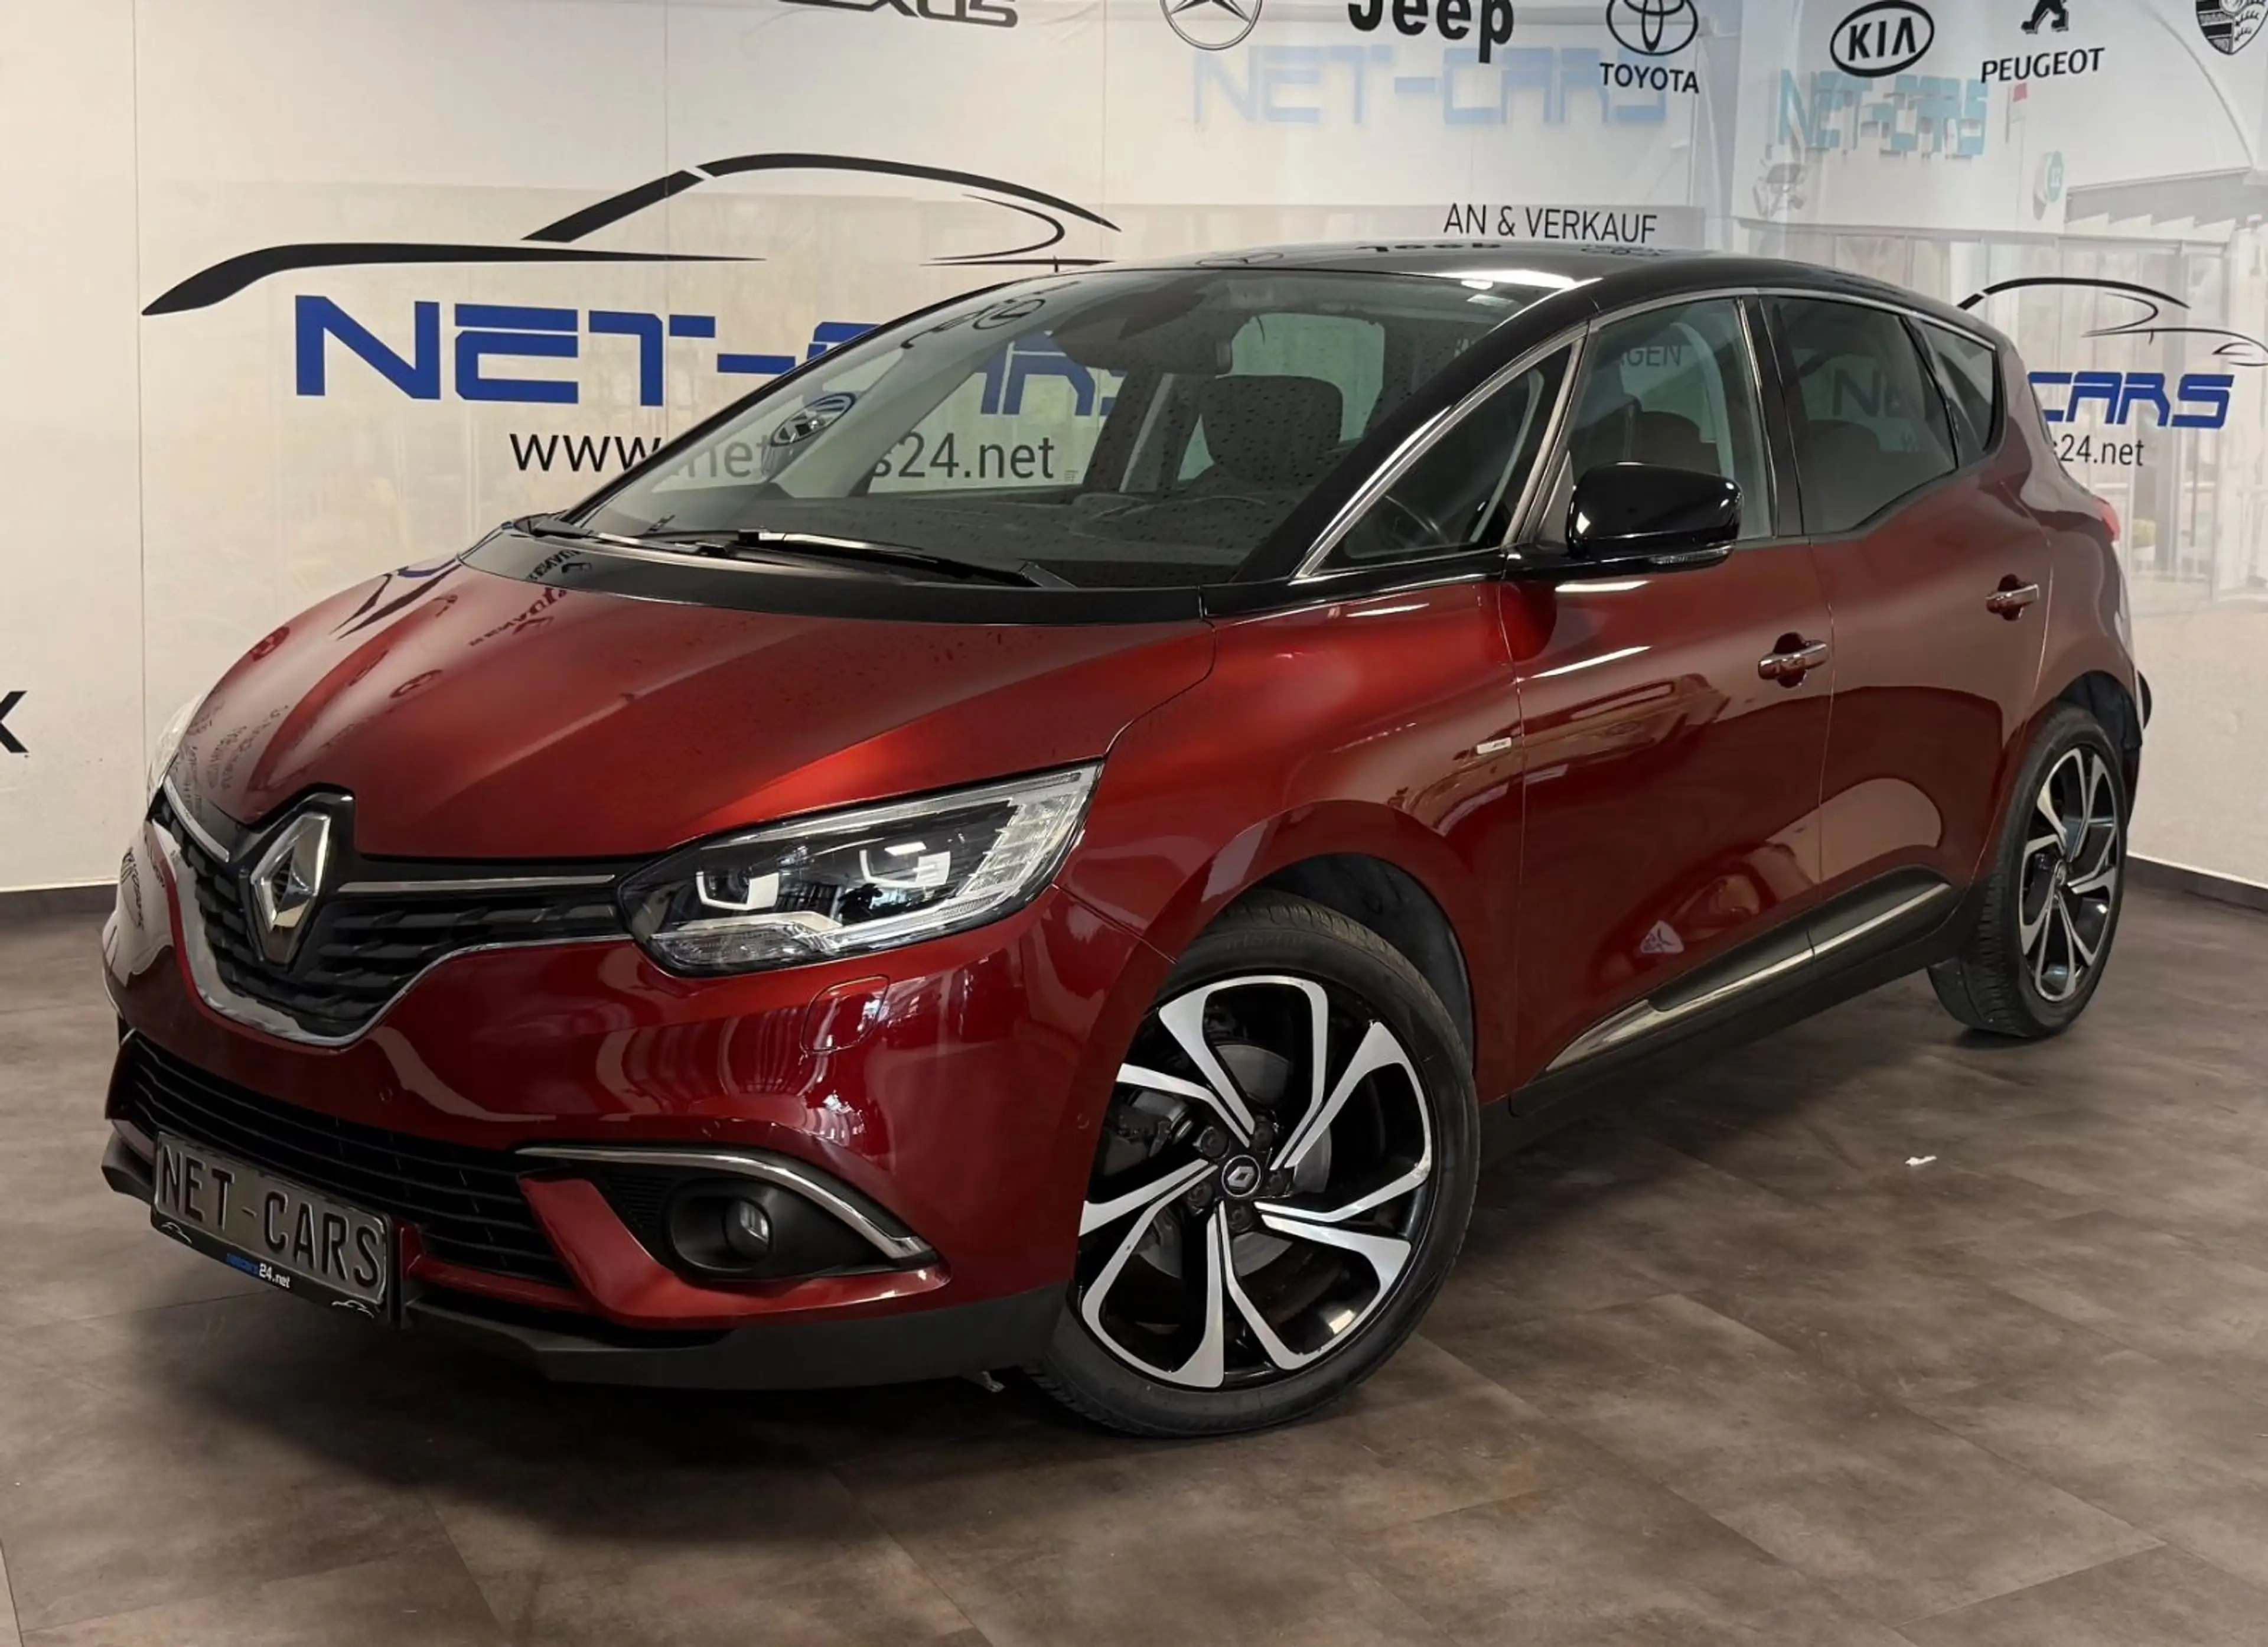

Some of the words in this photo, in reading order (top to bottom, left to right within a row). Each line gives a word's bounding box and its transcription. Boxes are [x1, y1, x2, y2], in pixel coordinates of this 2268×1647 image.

[1348, 0, 1514, 63] Jeep
[1847, 17, 1917, 61] KIA
[1193, 44, 1667, 125] NET-CARS
[1599, 63, 1700, 94] TOYOTA
[1981, 47, 2106, 83] PEUGEOT
[1443, 203, 1487, 235] AN
[1498, 205, 1516, 237] &
[1526, 207, 1658, 243] VERKAUF
